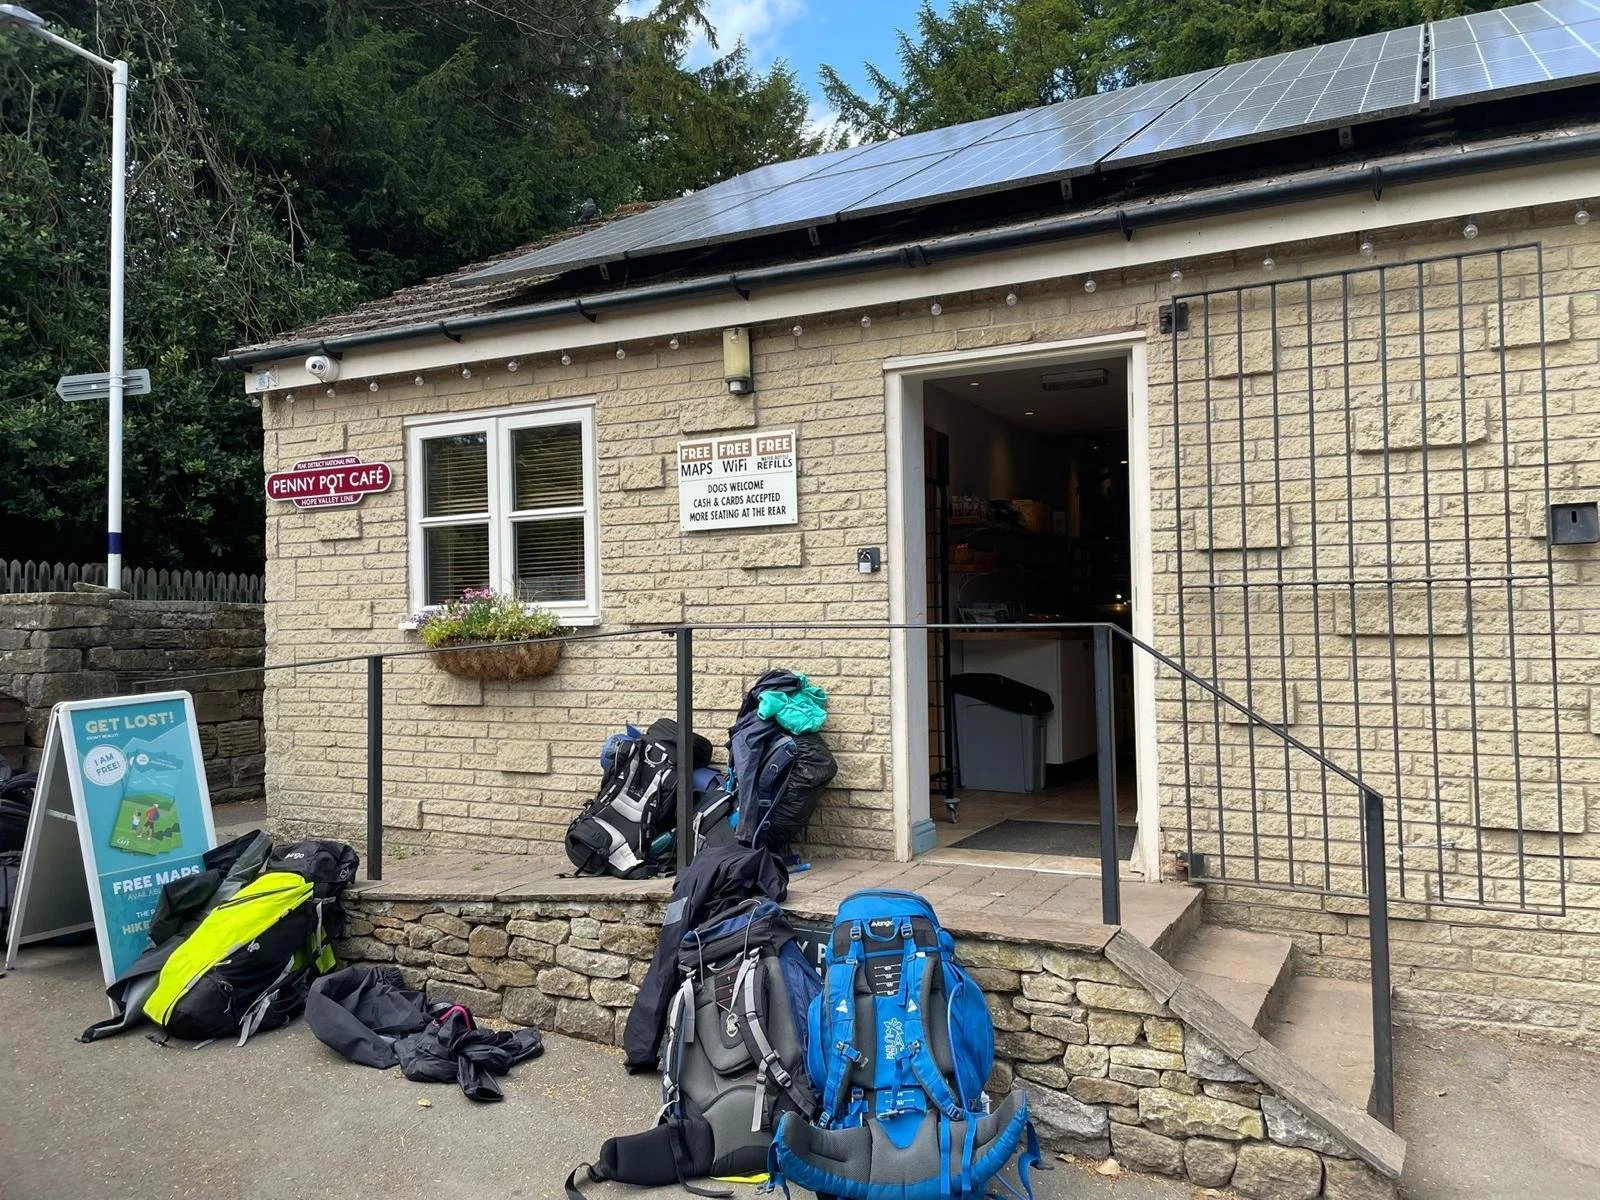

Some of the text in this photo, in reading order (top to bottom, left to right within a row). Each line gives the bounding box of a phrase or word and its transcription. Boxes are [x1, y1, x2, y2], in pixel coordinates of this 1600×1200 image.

[682, 438, 790, 460] FREE FREE FREE
[681, 459, 793, 477] MAPS WiFi REFILLS
[273, 466, 384, 494] PENNY POT CAFÉ
[708, 480, 764, 493] DOGS WELCOME
[301, 498, 317, 506] HOPE
[318, 496, 339, 504] VALLEY
[693, 493, 780, 508] CASH & CARDS ACCEPTED
[690, 505, 786, 522] MORE SEATING AT THE REAR
[85, 711, 174, 733] GET LOST!
[100, 753, 114, 764] AM
[96, 761, 120, 776] FREE!
[113, 865, 200, 895] FREE MAPS
[136, 910, 150, 918] THE
